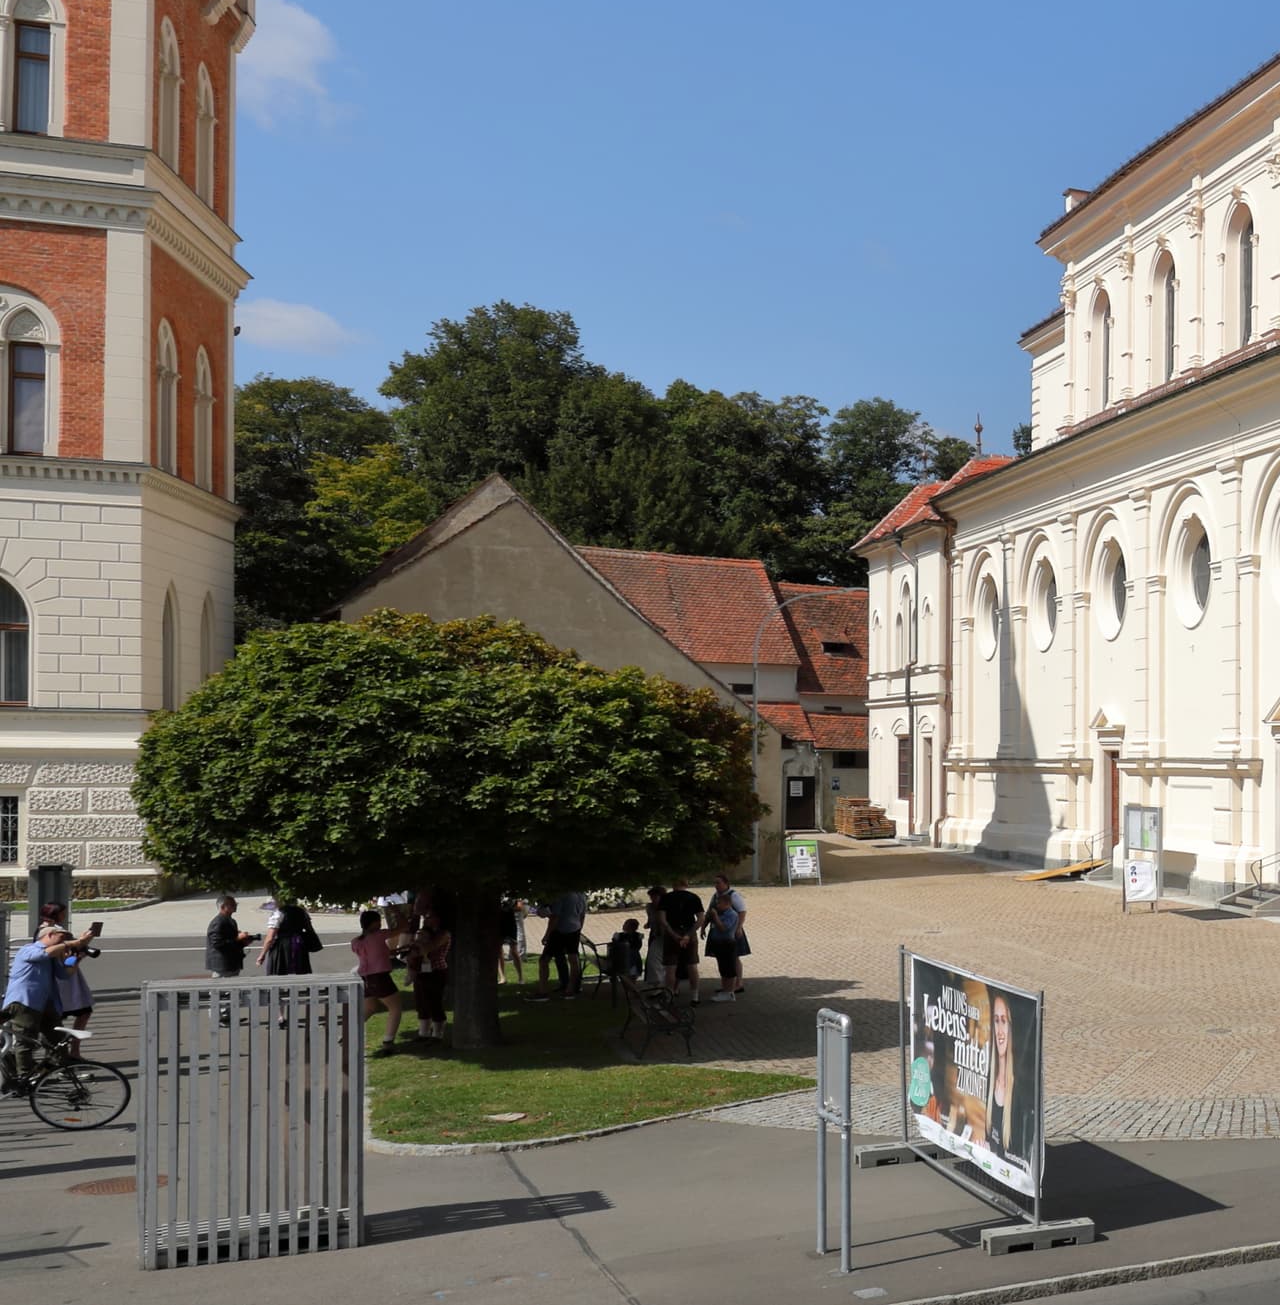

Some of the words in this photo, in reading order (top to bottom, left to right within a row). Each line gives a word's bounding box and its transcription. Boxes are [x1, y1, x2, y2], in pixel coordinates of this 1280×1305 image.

[923, 993, 970, 1041] Lebens.
[942, 985, 953, 1011] MIT
[953, 987, 968, 1017] UNS
[953, 1026, 990, 1077] mittel
[956, 1066, 988, 1103] ZUKUNFT
